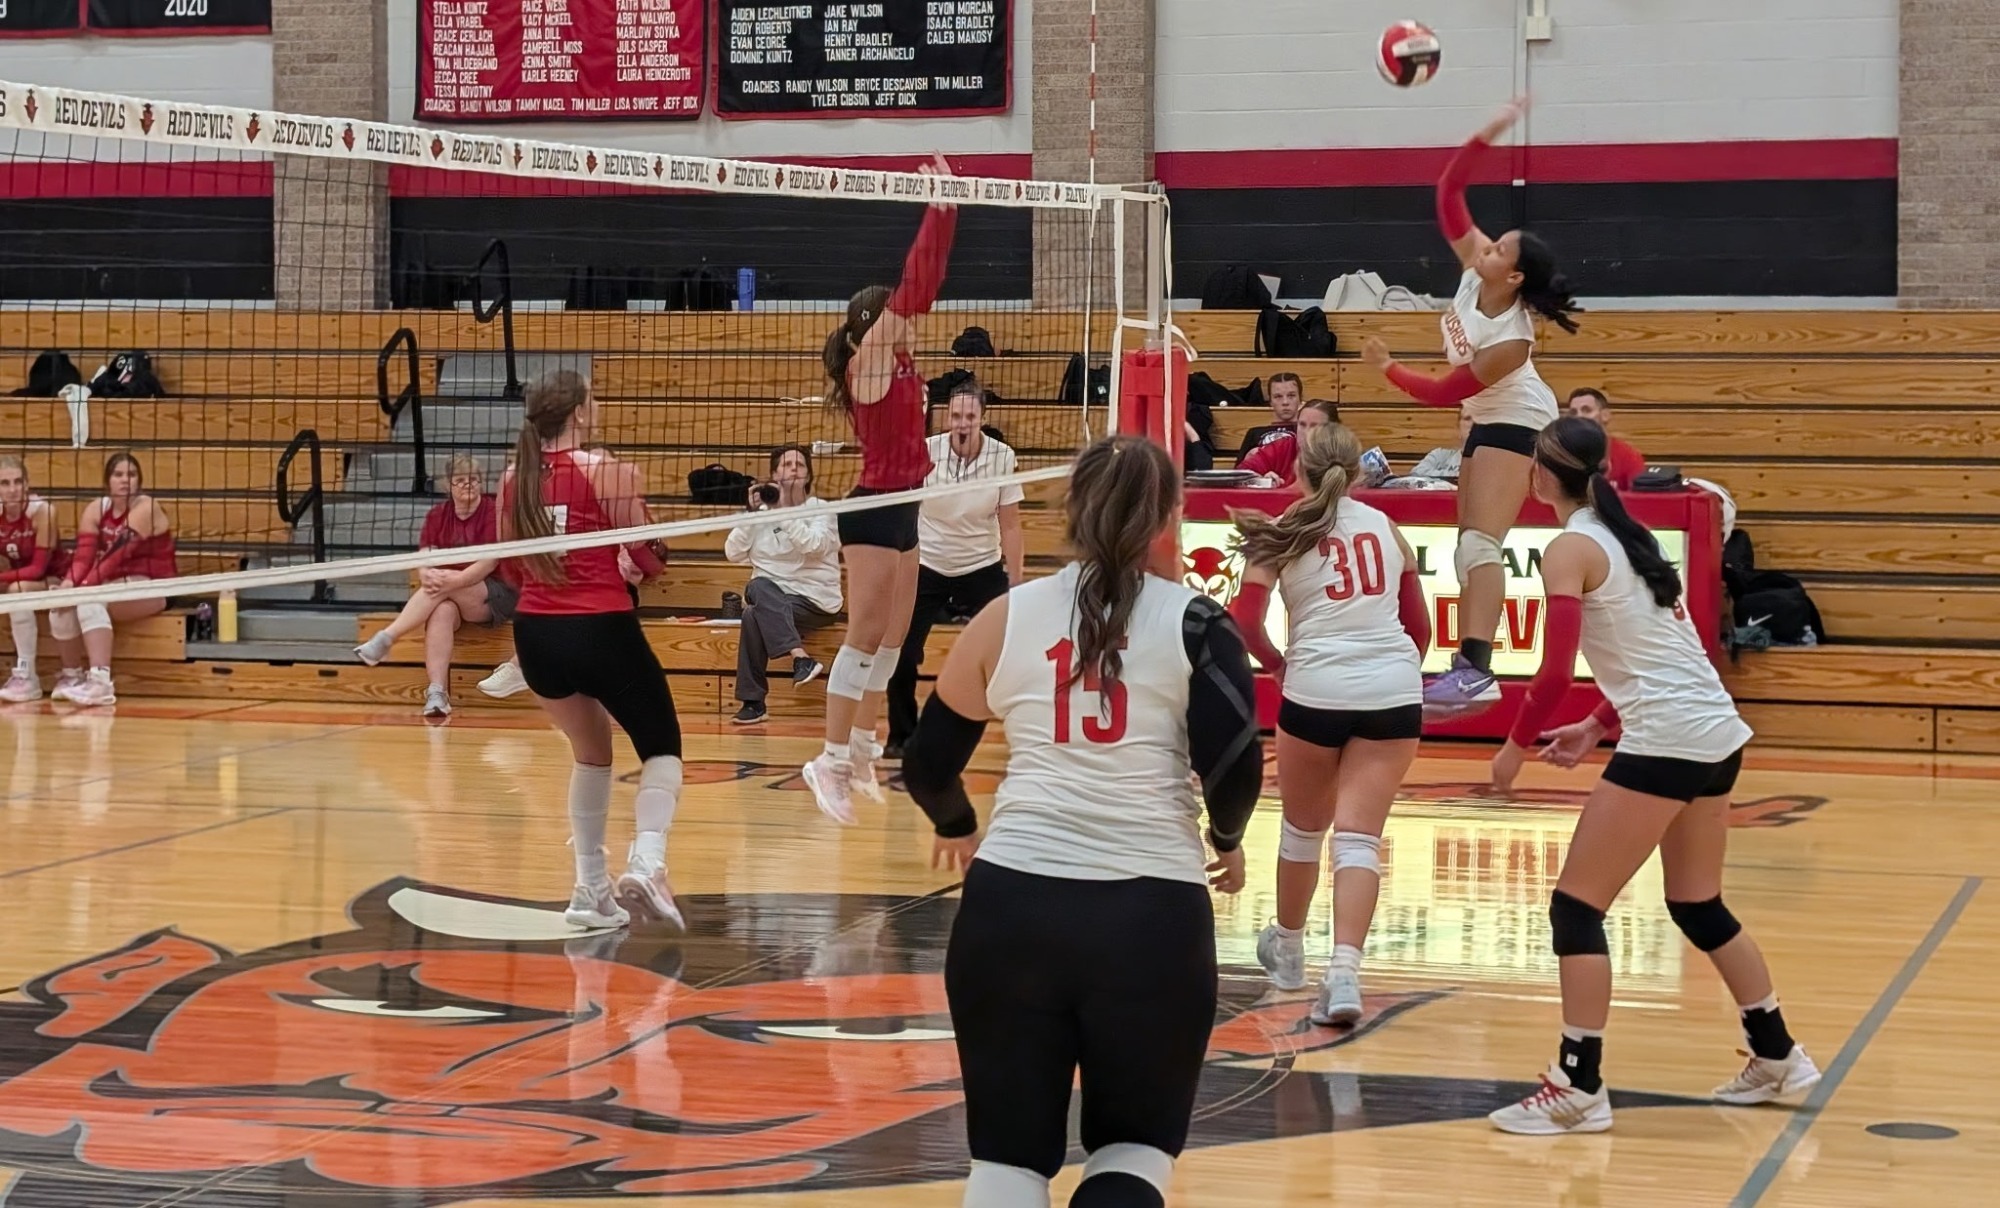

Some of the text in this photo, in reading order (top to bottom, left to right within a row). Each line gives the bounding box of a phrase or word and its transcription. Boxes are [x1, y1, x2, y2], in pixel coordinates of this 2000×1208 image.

[164, 0, 208, 16] 2020
[433, 1, 461, 14] STELLA
[545, 0, 567, 12] WESS
[642, 0, 670, 10] WILSON
[824, 4, 883, 18] JAKE WILSON
[927, 2, 954, 16] DEVON
[616, 12, 638, 25] ABBY
[730, 6, 812, 21] AIDEN LECHLEITNER
[433, 15, 452, 28] ELLA
[730, 22, 792, 34] CODY ROBERTS
[824, 20, 858, 32] IAN RAY
[927, 16, 994, 30] ISAAC BRADLEY
[522, 27, 561, 40] ANNA DILL
[616, 26, 680, 39] MARLOW SOYKA
[824, 33, 893, 46] HENRY BRADLEY
[927, 30, 992, 44] CALEB MAKOSY
[522, 40, 582, 54] CAMPBELL MOSS
[616, 40, 668, 53] JULS CASPER
[730, 36, 786, 49] EVAN GEORGE
[522, 56, 572, 68] JENNA SMITH
[617, 54, 679, 68] ELLA ANDERSON
[730, 50, 792, 64] DOMINIC KUNTZ
[824, 48, 914, 62] TANNER ARCHANGELO
[434, 57, 498, 70] TINA HILDEBRAND
[434, 71, 457, 84] BECCA
[522, 70, 578, 82] KARLIE HEENEY
[617, 68, 690, 82] LAURA HEINZEROTH
[434, 85, 457, 98] TESSA
[742, 76, 983, 94] COACHES RANDY WILSON BRYCE DESCAVISH TIM MILLER
[424, 98, 456, 112] COACHES
[484, 99, 512, 112] WILSON
[516, 98, 541, 111] TAMMY
[571, 98, 584, 111] TIM
[586, 98, 610, 110] MILLER
[614, 98, 630, 110] LISA
[663, 96, 681, 110] JEFF
[811, 92, 917, 108] TYLER GIBSON JEFF DICK
[54, 96, 126, 130] RED DEVILS
[166, 110, 233, 140] RED DEVILS
[272, 120, 297, 144] RED
[366, 128, 386, 152] RED
[451, 140, 472, 162] RED
[1445, 308, 1472, 357] USHERS
[1317, 531, 1386, 601] 30
[1045, 636, 1128, 744] 15
